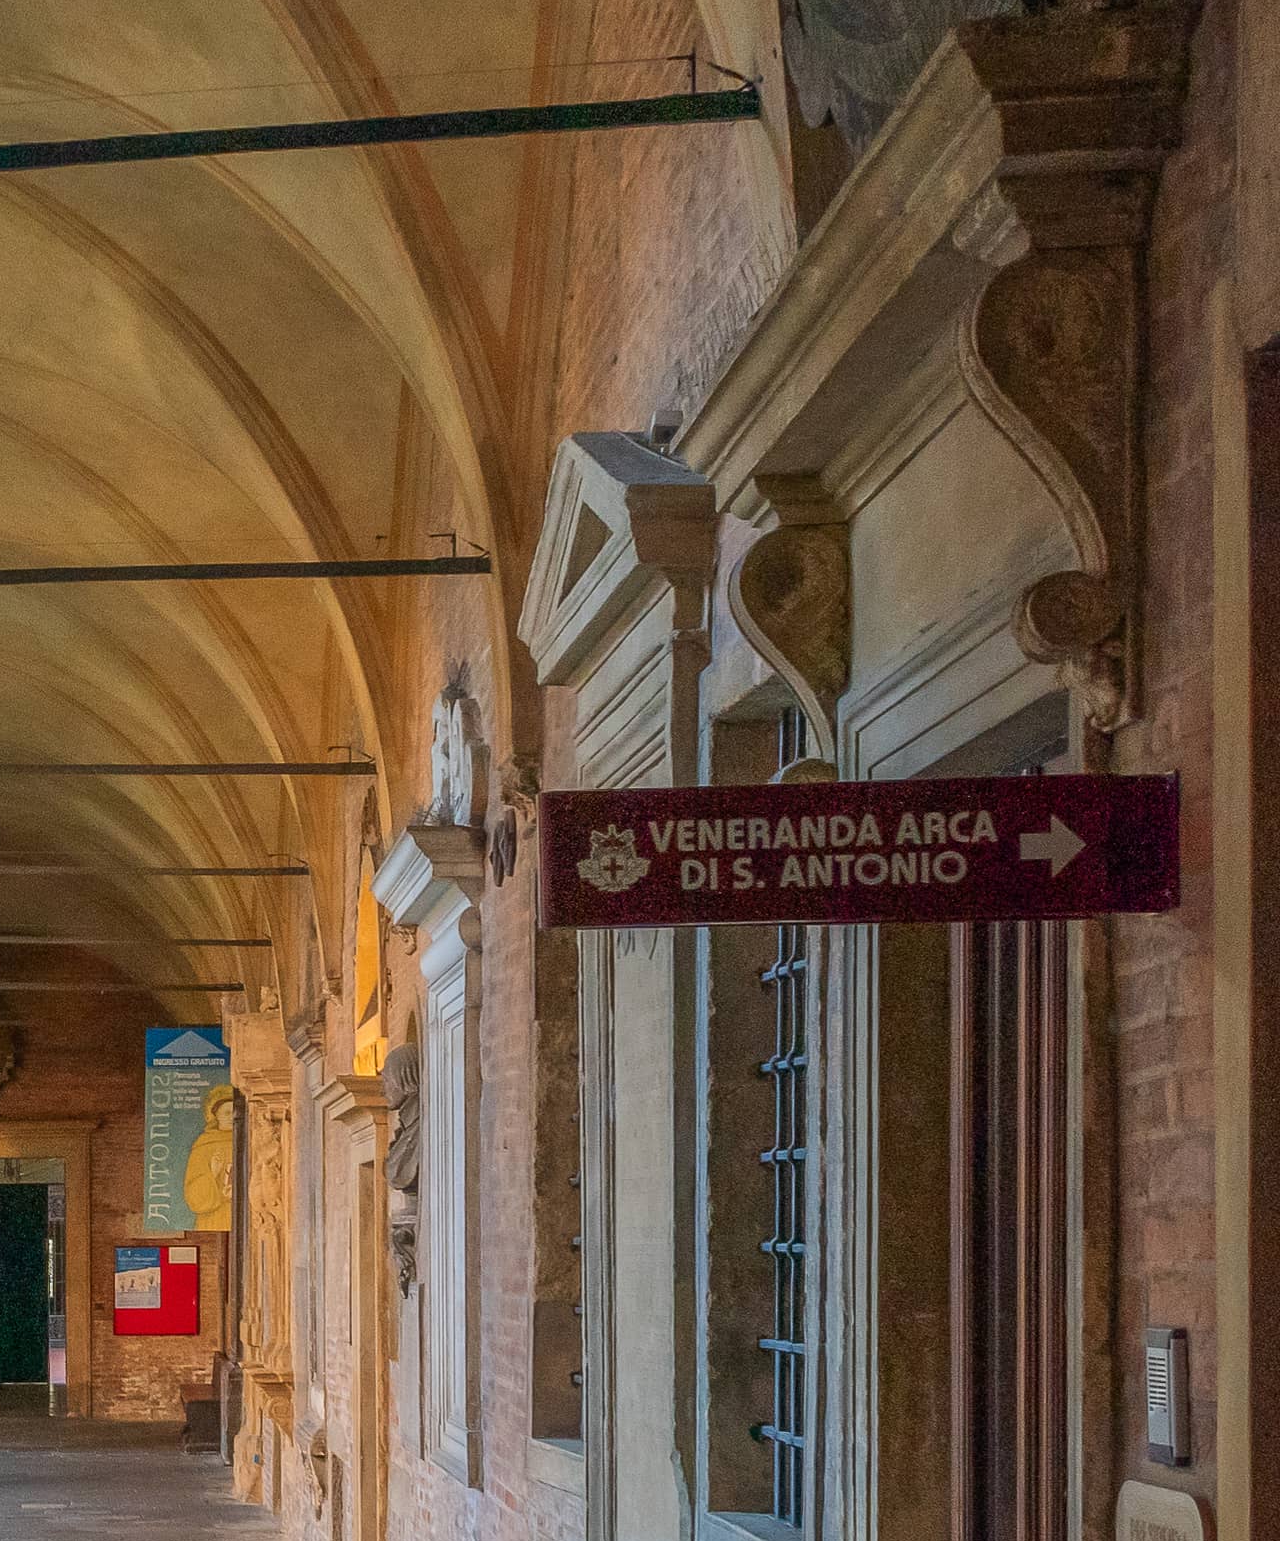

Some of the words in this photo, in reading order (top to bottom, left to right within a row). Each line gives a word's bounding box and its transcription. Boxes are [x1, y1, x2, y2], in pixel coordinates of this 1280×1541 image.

[649, 813, 883, 853] VENERANDA
[894, 810, 998, 845] ARCA
[680, 858, 719, 890] DI
[732, 856, 765, 890] S.
[780, 850, 967, 888] ANTONIO
